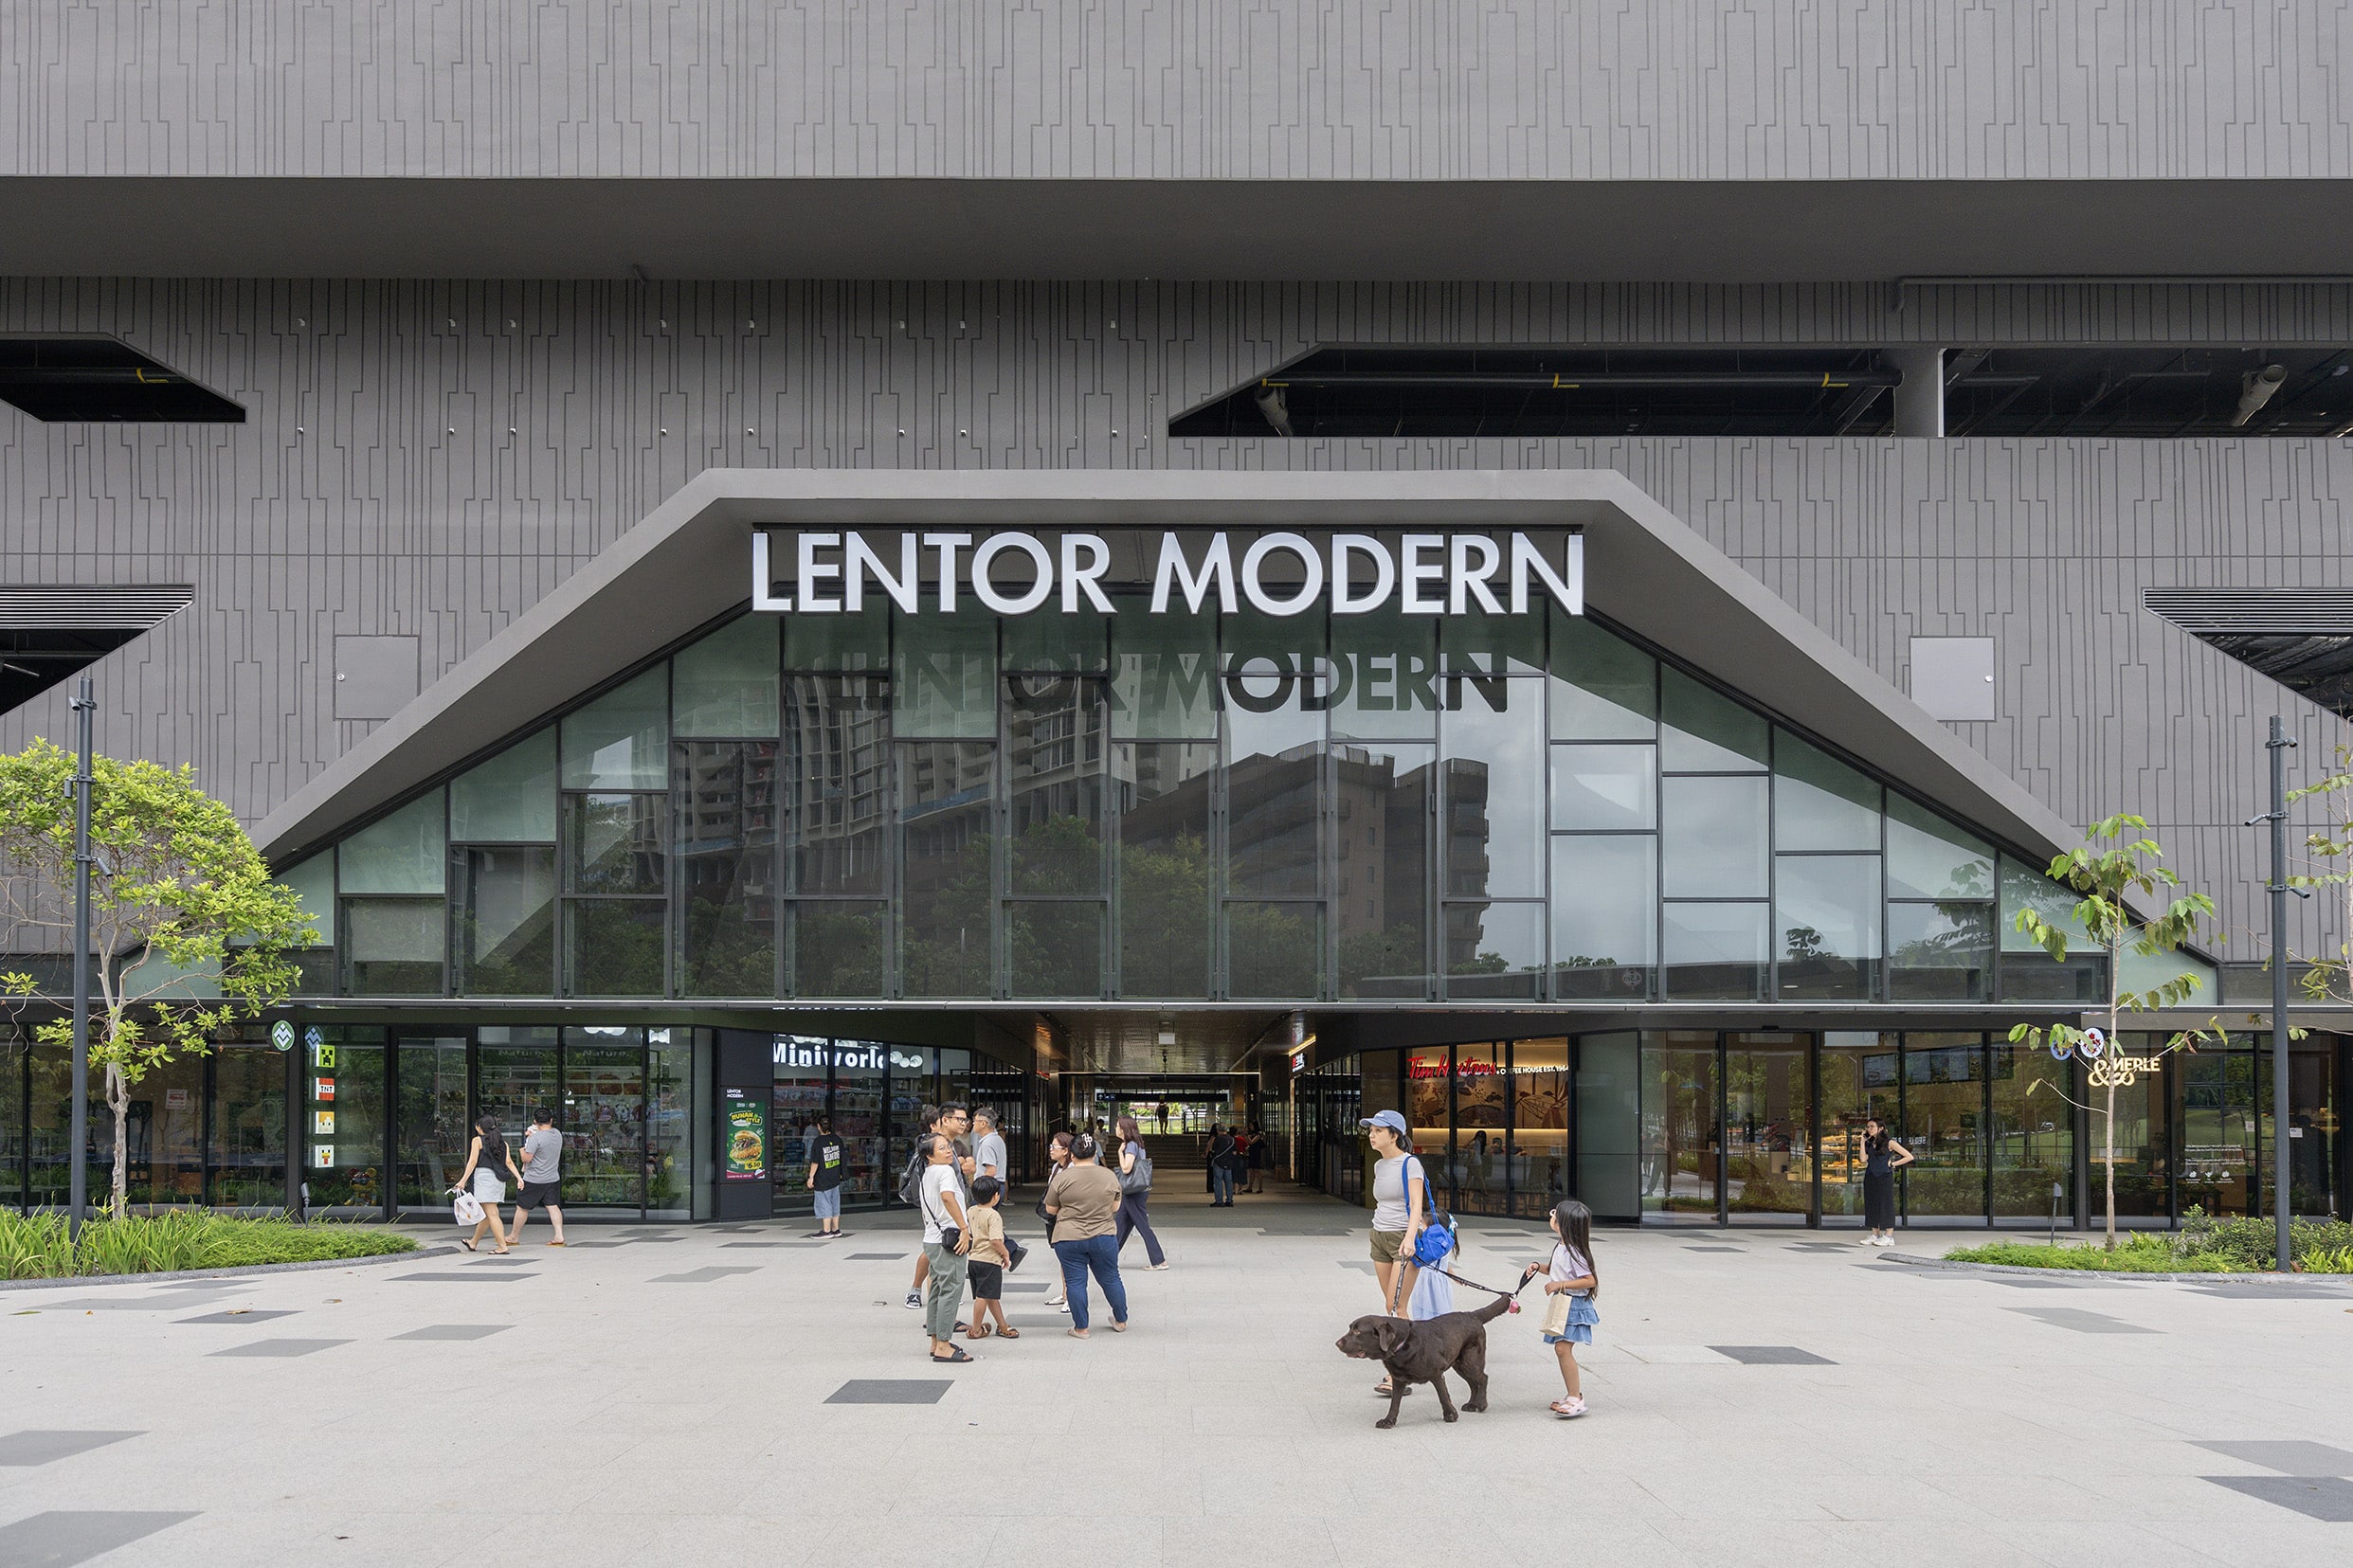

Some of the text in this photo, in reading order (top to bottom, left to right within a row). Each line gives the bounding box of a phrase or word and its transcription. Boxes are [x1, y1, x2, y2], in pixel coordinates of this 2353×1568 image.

[752, 531, 1584, 617] LENTOR MODERN
[1407, 1055, 1433, 1079] Tim
[1436, 1053, 1496, 1077] Hrtons
